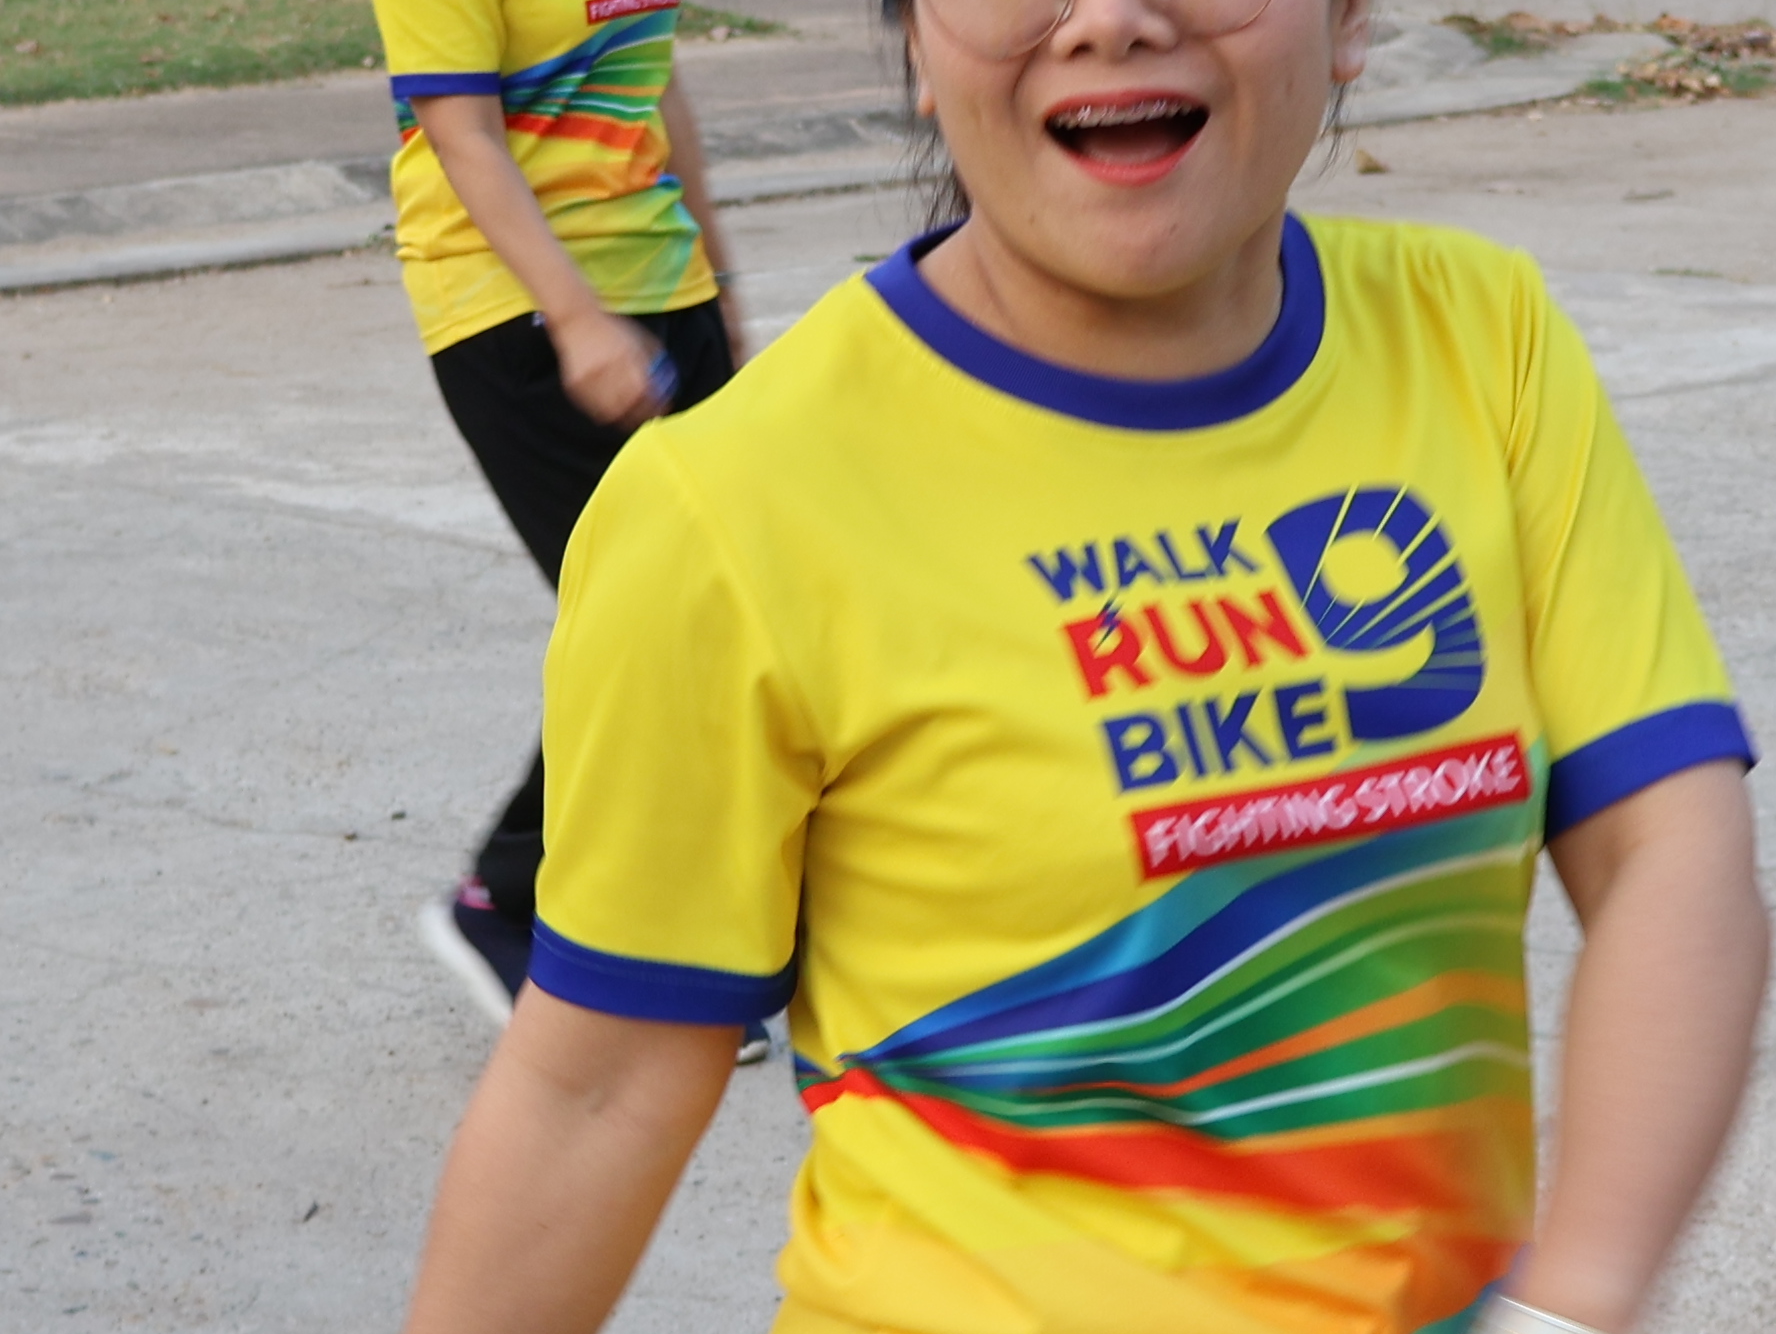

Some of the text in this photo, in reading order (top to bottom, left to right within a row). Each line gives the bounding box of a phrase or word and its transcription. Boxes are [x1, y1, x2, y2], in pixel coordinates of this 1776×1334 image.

[1027, 515, 1262, 602] WALK
[1060, 588, 1312, 703] RUN
[1097, 672, 1336, 796] BIKE
[1144, 743, 1523, 867] FIGHTING STROKE
